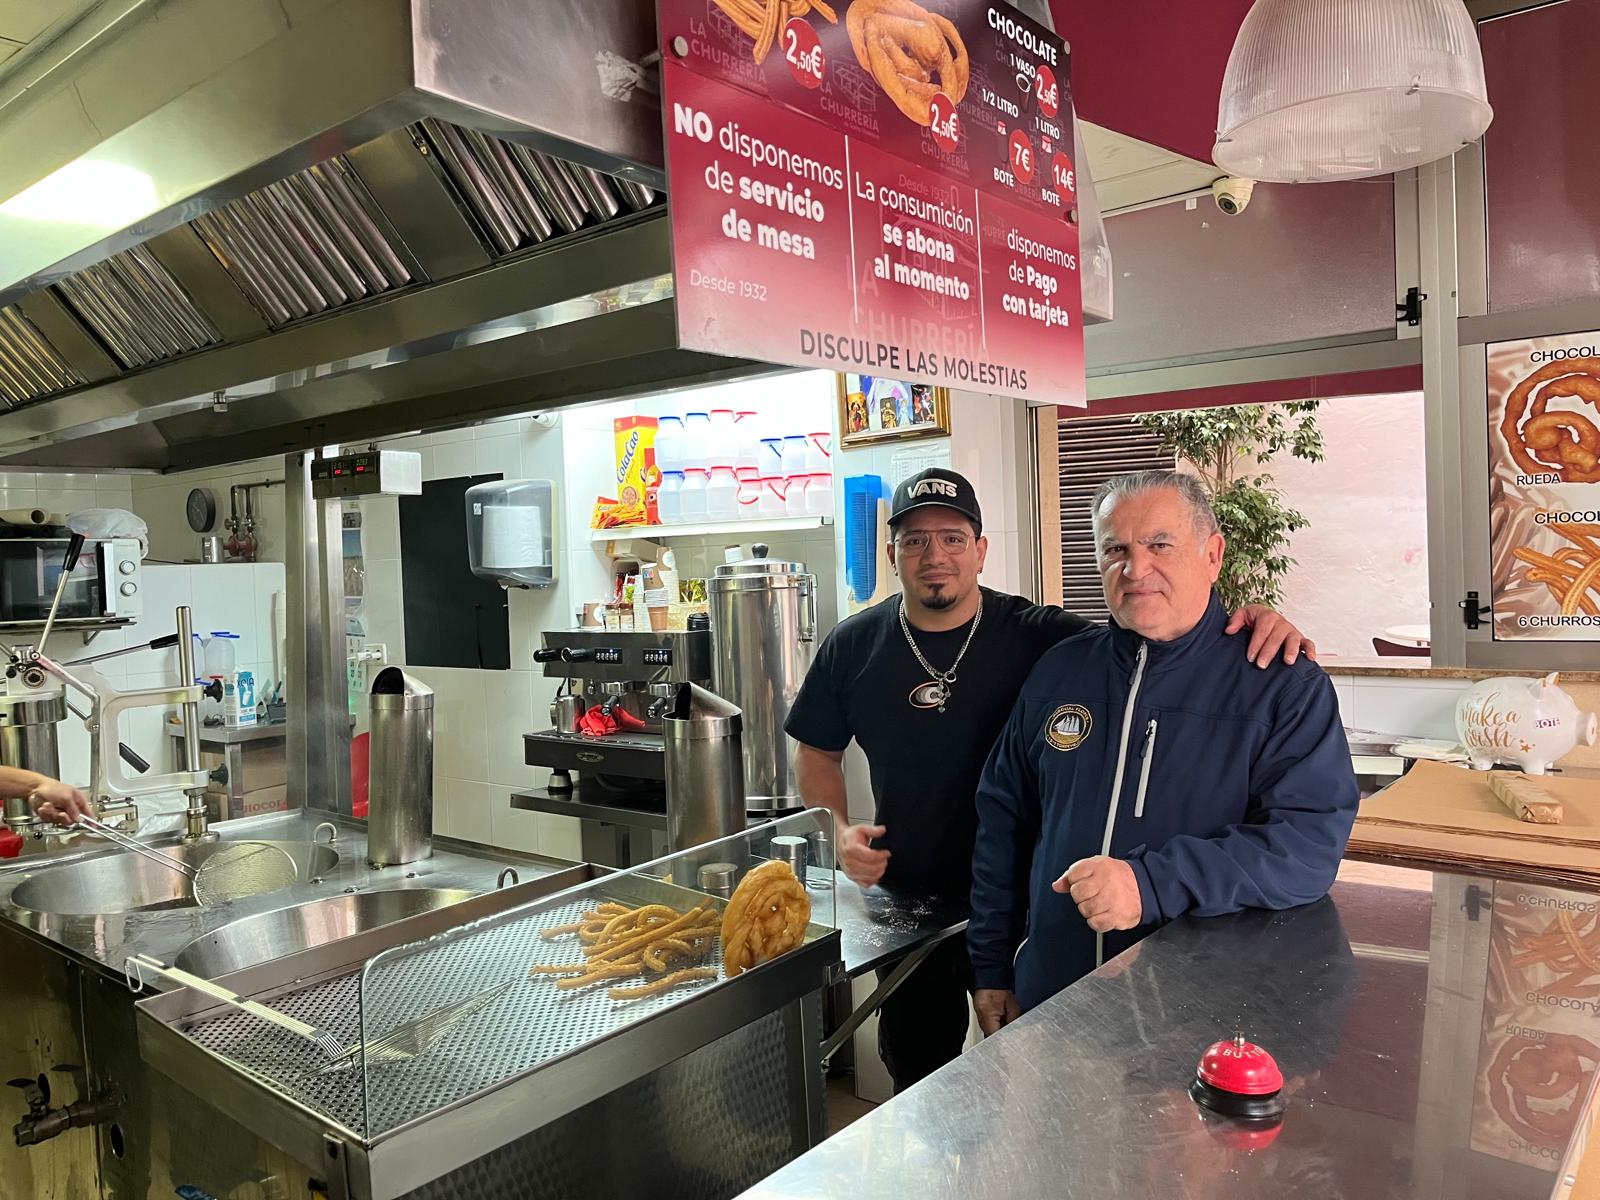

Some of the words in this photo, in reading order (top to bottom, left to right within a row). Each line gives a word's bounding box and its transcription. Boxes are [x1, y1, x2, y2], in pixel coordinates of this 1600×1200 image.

[987, 7, 1058, 67] CHOCOLATE
[1010, 53, 1015, 66] 1
[1016, 56, 1036, 79] VASO
[956, 100, 998, 127] HURRERÍA
[982, 88, 996, 107] 1/2
[996, 94, 1019, 118] LITRO
[673, 102, 713, 143] NO
[718, 121, 844, 190] disponemos
[1040, 118, 1060, 140] LITRO
[1013, 143, 1031, 172] 7€
[704, 160, 734, 194] de
[739, 176, 825, 223] servicio
[993, 167, 1015, 188] BOTE
[1053, 164, 1075, 192] 14€
[855, 171, 875, 202] La
[879, 186, 974, 236] consumición
[1042, 188, 1060, 207] BOTE
[721, 208, 752, 242] de
[757, 223, 816, 260] mesa
[882, 222, 903, 247] se
[906, 228, 955, 263] abona
[1007, 228, 1076, 271] disponemos
[690, 268, 736, 295] Desde
[739, 279, 768, 302] 1932
[873, 254, 891, 281] al
[894, 262, 970, 301] momento
[1008, 260, 1025, 284] de
[1026, 265, 1058, 297] Pago
[1002, 293, 1027, 317] con
[1029, 298, 1069, 328] tarjeta
[799, 329, 900, 370] DISCULPE
[906, 348, 938, 376] LAS
[943, 355, 1028, 391] MOLESTIAS
[1530, 346, 1600, 363] CHOCOL
[616, 431, 639, 484] ColaCao
[907, 478, 958, 500] VANS
[1516, 473, 1561, 486] RUEDA
[1519, 616, 1527, 627] 6
[1529, 616, 1600, 628] CHURROS
